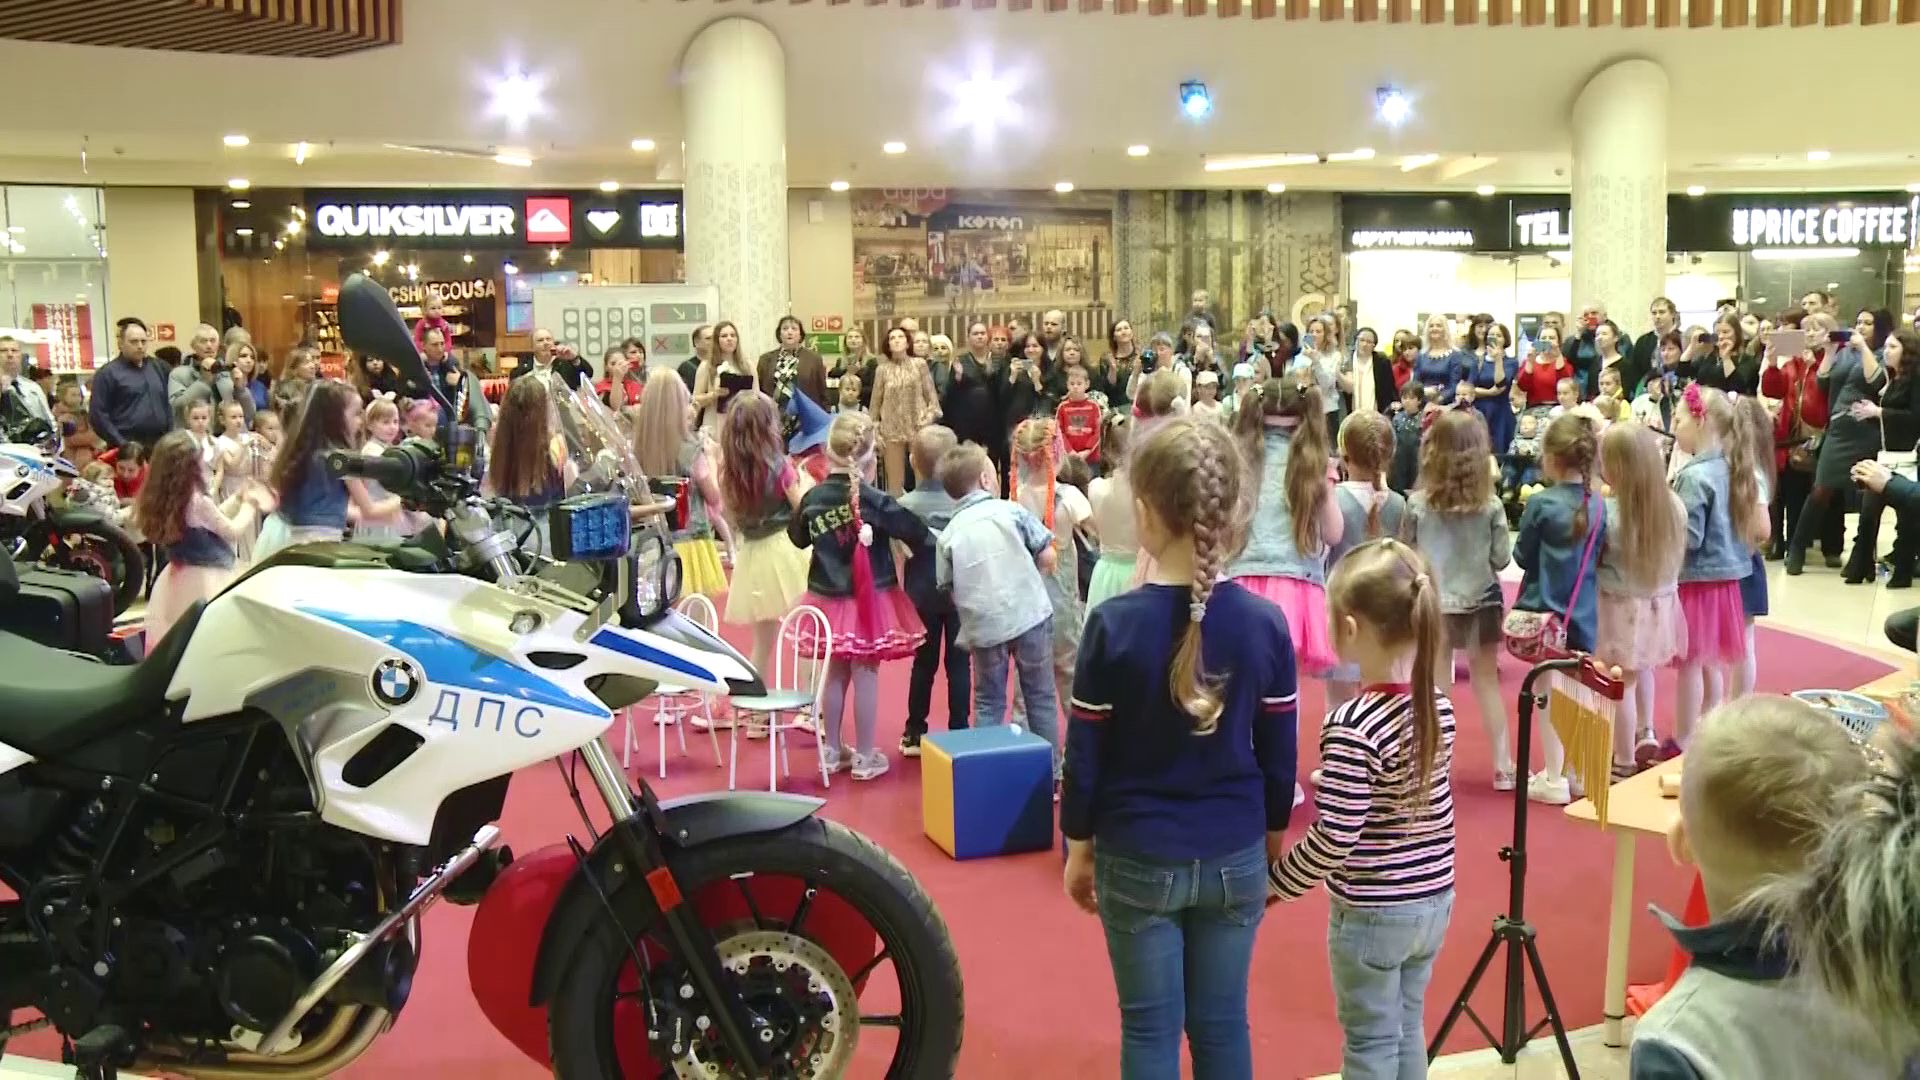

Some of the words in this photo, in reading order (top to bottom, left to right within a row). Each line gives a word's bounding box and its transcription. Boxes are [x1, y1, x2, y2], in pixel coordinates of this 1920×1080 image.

[316, 205, 515, 237] QUIKSILVER
[1516, 208, 1572, 246] TEL
[1750, 208, 1820, 245] PRICE
[1822, 206, 1908, 245] COFFEE
[428, 689, 544, 738] ДПС
